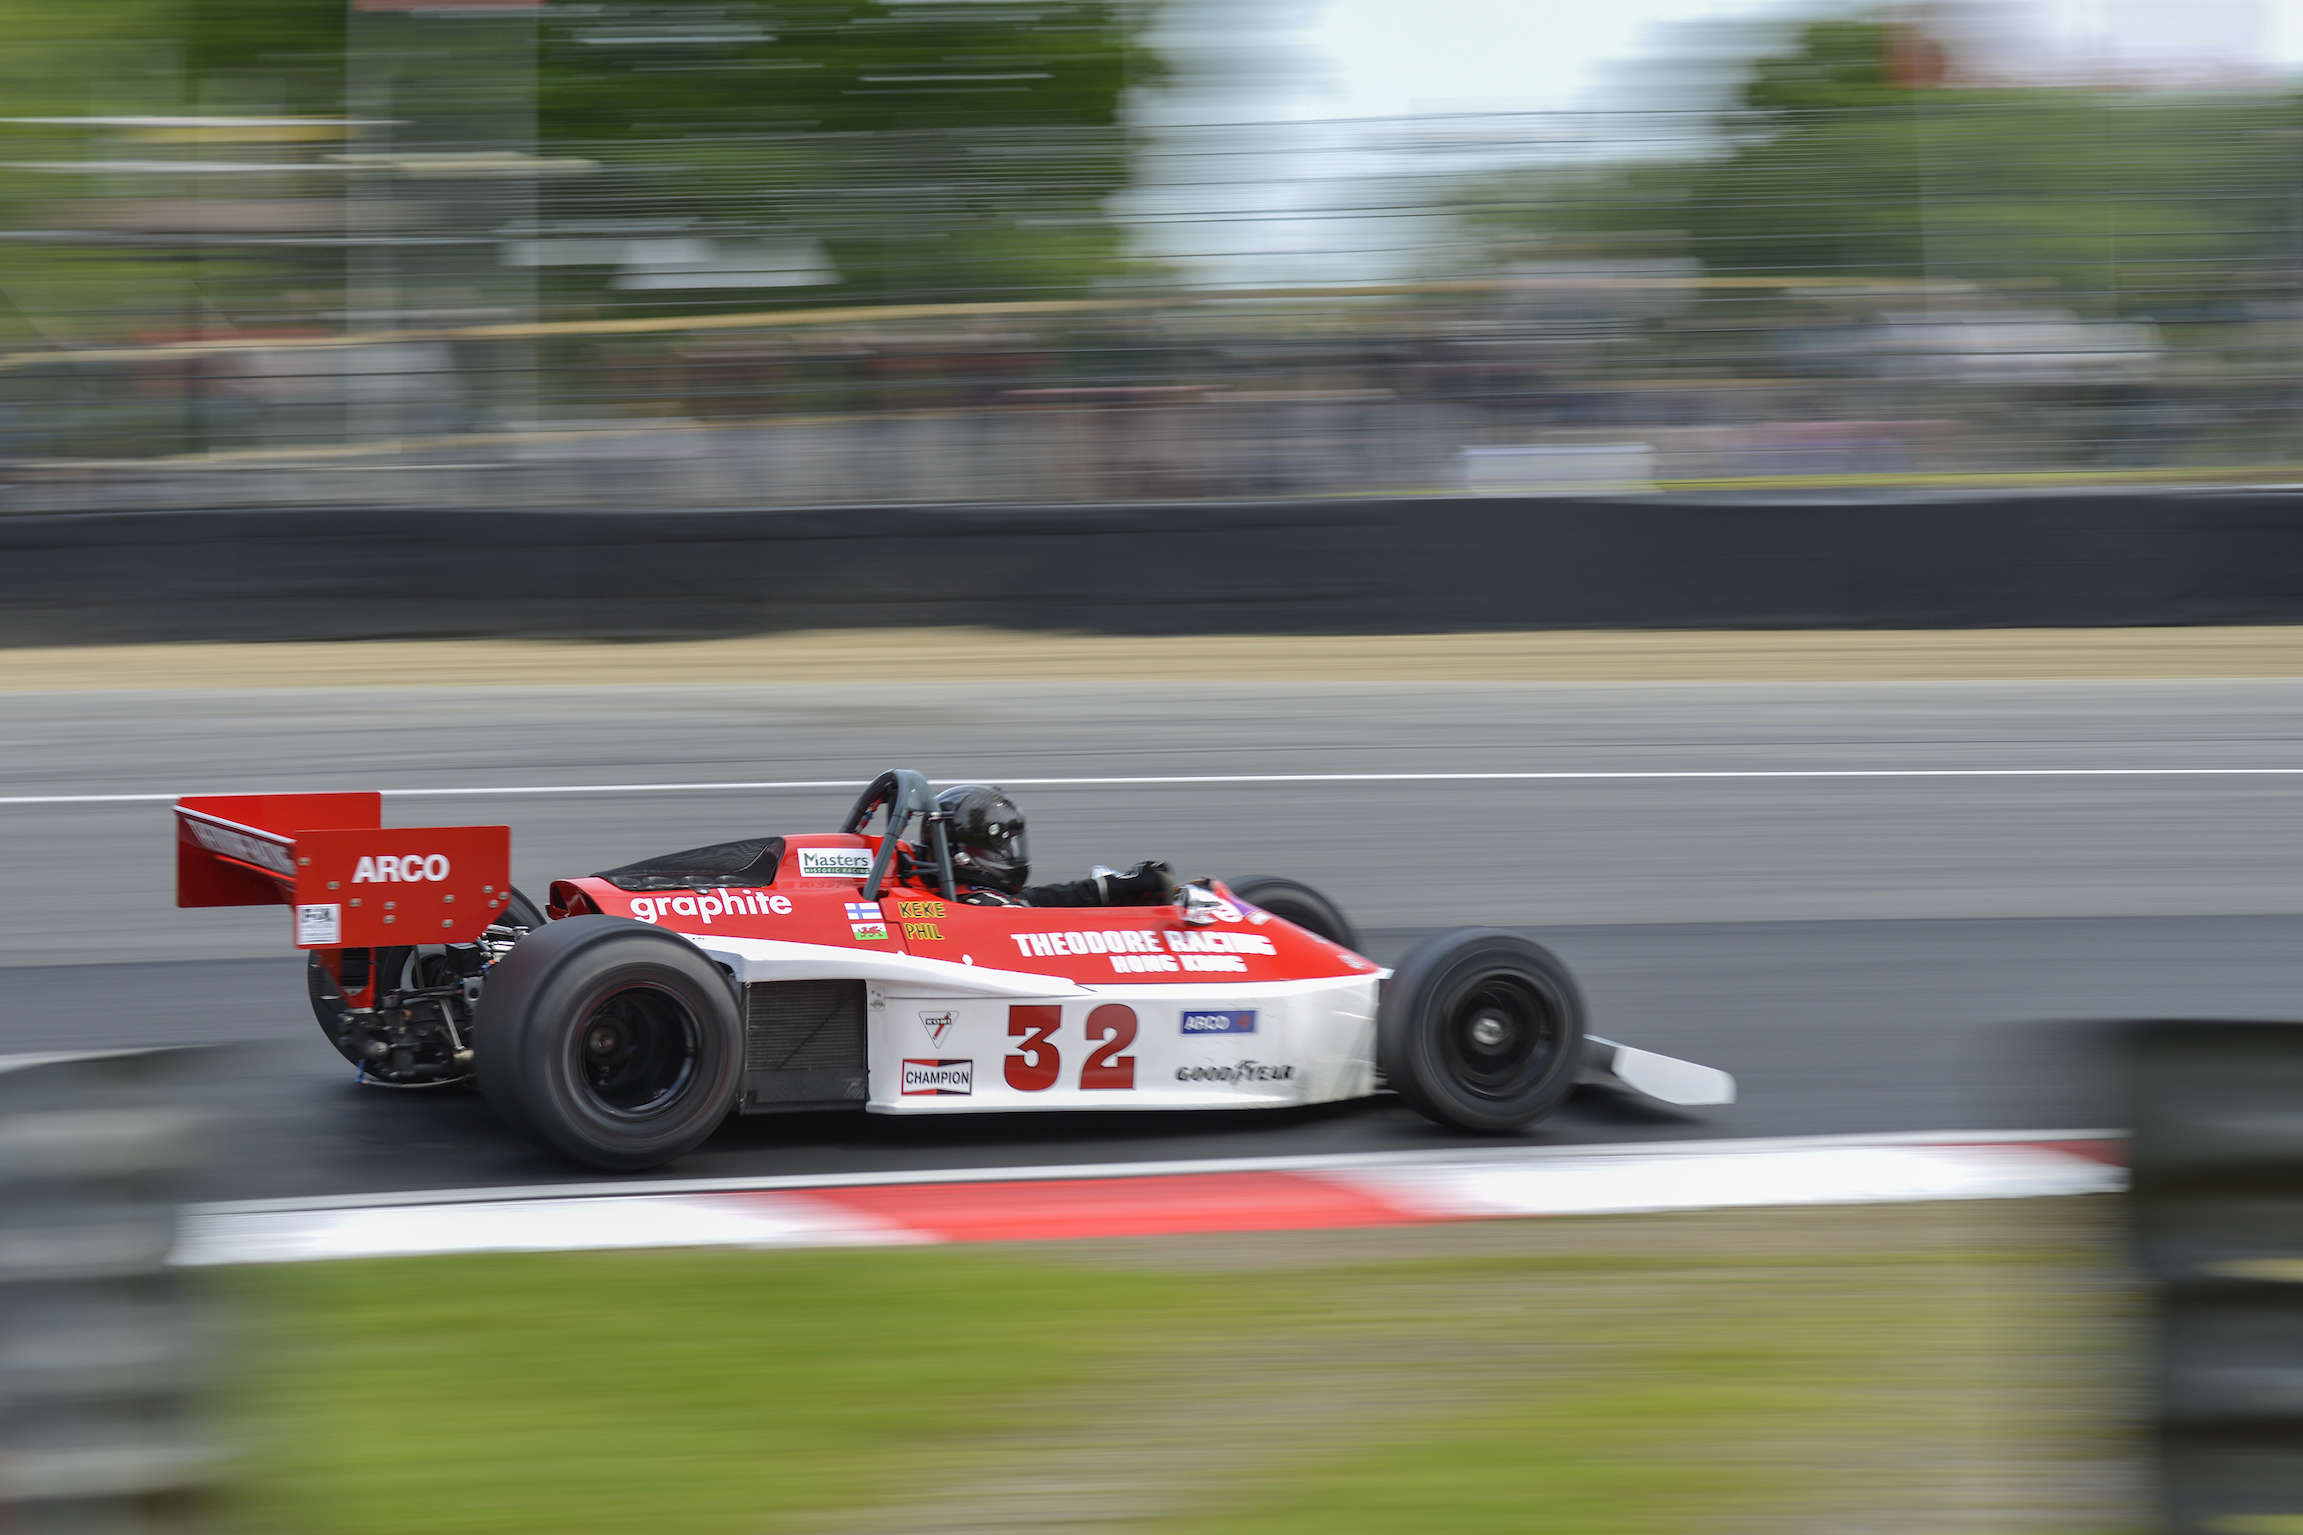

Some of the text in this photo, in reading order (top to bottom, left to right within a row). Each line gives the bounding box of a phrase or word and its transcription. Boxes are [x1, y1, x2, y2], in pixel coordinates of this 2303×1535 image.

[351, 853, 451, 884] ARCO
[803, 852, 869, 867] Masters
[629, 887, 793, 925] graphite
[897, 901, 947, 919] KEKE
[903, 922, 946, 940] PHIL
[1010, 930, 1164, 957] THEODORE
[1162, 930, 1277, 956] RACING
[1109, 955, 1180, 973] HONG
[1183, 1015, 1231, 1031] ARCO
[1003, 1003, 1139, 1092] 32
[905, 1070, 969, 1085] CHAMPION
